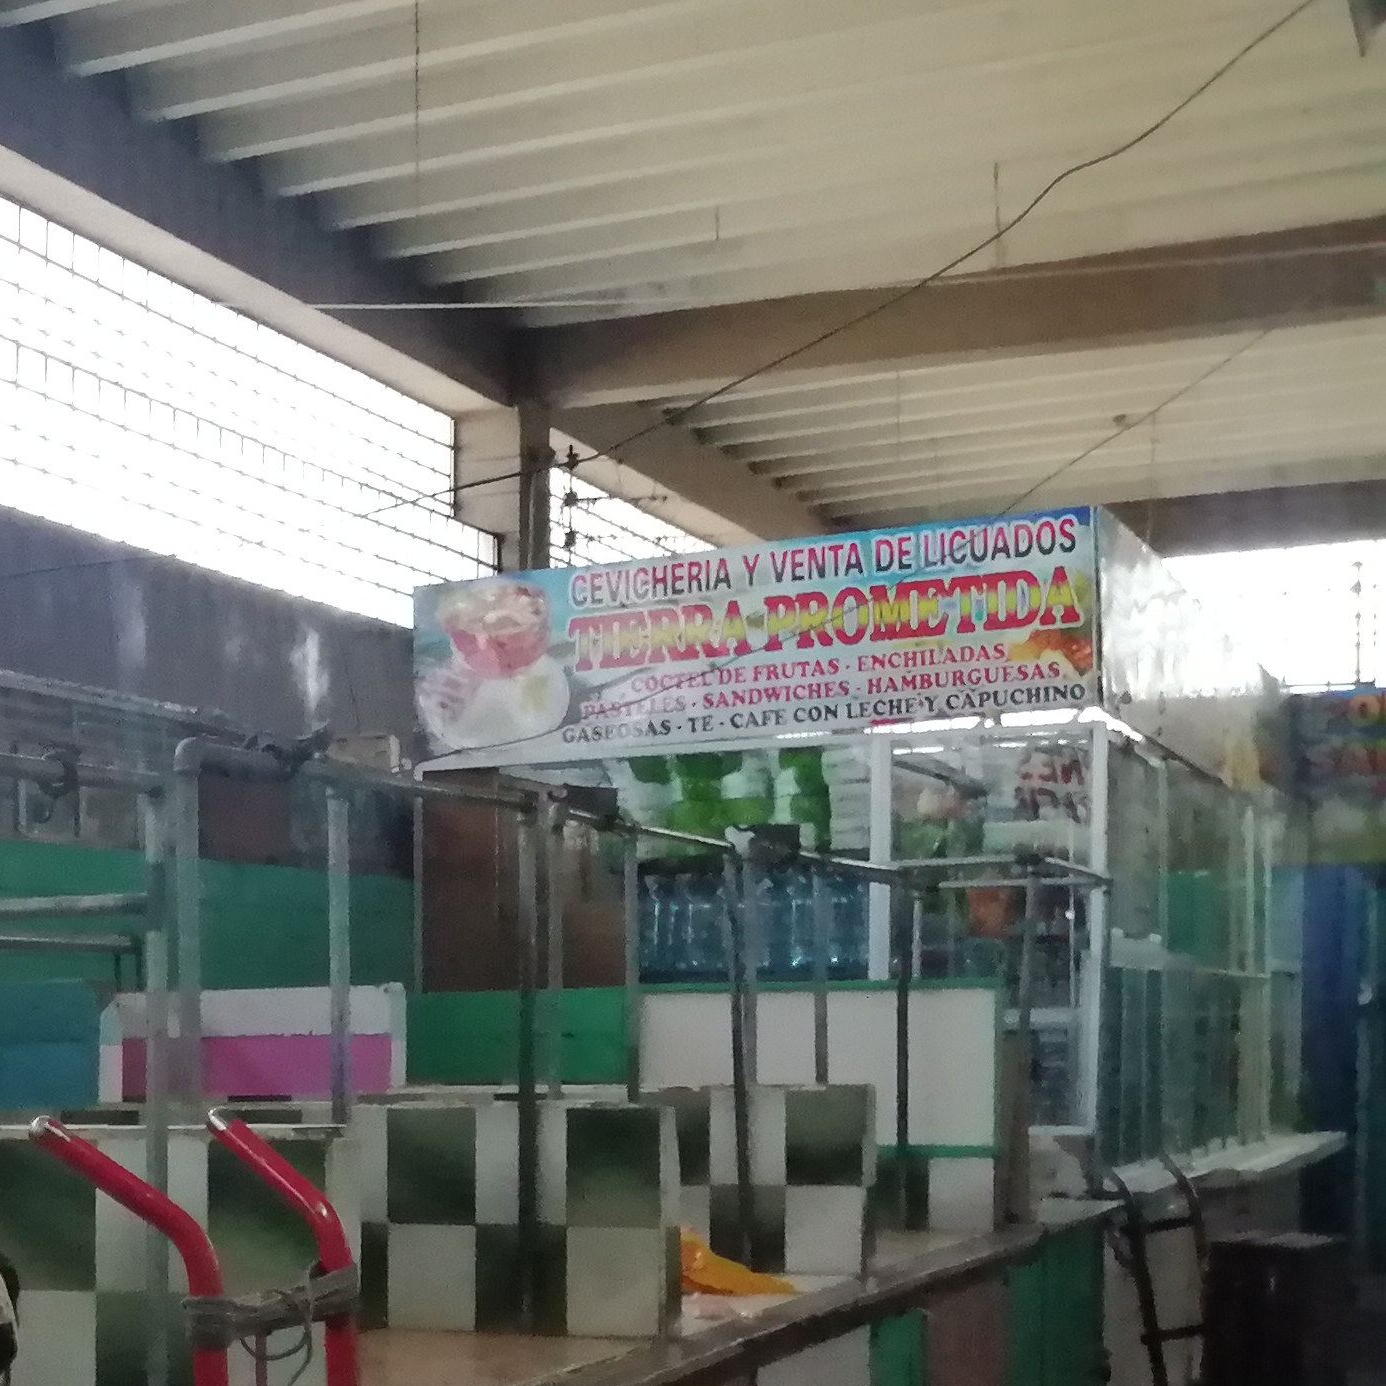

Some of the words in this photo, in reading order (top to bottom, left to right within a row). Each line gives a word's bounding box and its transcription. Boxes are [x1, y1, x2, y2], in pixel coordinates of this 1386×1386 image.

[570, 557, 732, 606] CEVICHERIA
[742, 553, 760, 587] Y
[770, 542, 864, 583] VENTA
[875, 536, 913, 573] DE
[923, 518, 1077, 568] LICUADOS
[568, 600, 752, 672] TIERRA
[763, 566, 1082, 653] PROMETIDA
[703, 680, 850, 710] SANDWICHES
[867, 661, 1061, 695] HAMBURGUESAS
[717, 667, 747, 686] DE
[752, 656, 840, 683] FRUTAS
[857, 643, 1006, 672] ENCHILADAS
[688, 714, 714, 733] TE
[730, 708, 787, 729] CAFE
[793, 702, 839, 723] CON
[846, 698, 920, 719] LECHE
[924, 694, 937, 713] Y
[946, 683, 1086, 711] CAPUCHINO
